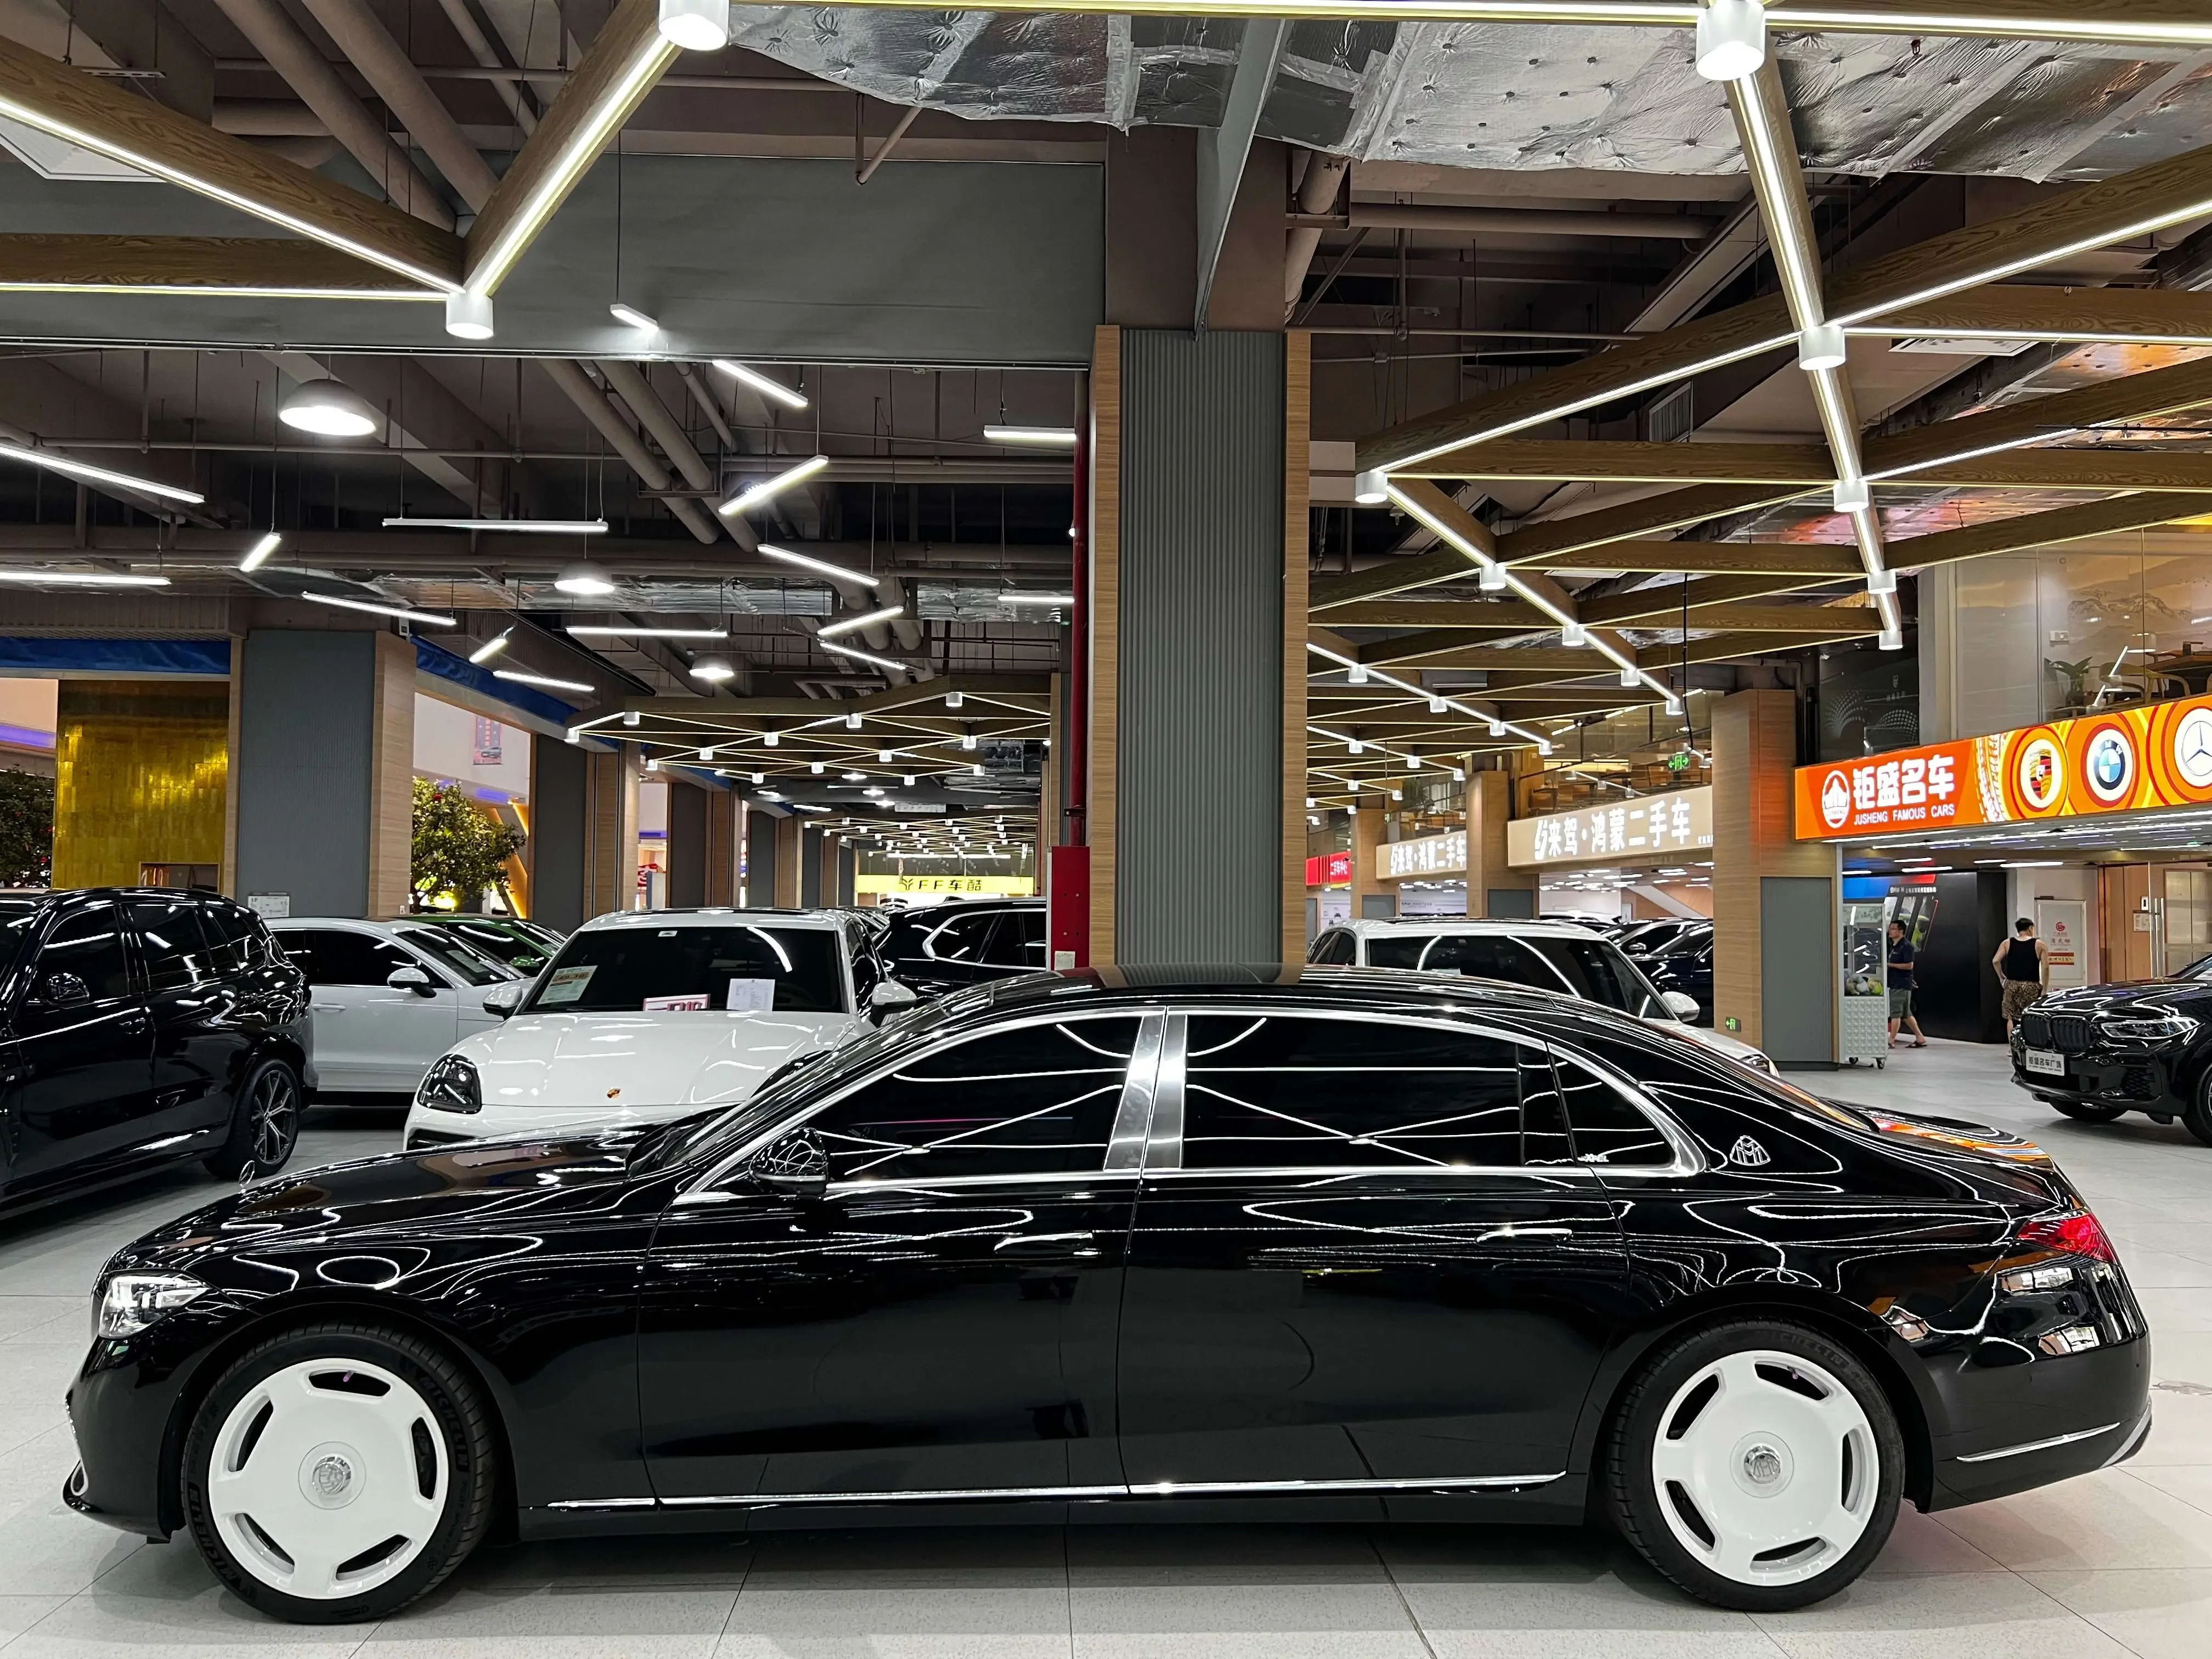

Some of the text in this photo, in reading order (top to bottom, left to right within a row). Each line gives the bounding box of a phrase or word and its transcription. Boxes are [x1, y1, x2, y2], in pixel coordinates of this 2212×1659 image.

[1853, 754, 1955, 810] 钜盛名车
[1854, 803, 1955, 826] JUSHENG FAMOUS CARS
[918, 879, 983, 891] FF车酷
[188, 1486, 239, 1584] MICHELIN
